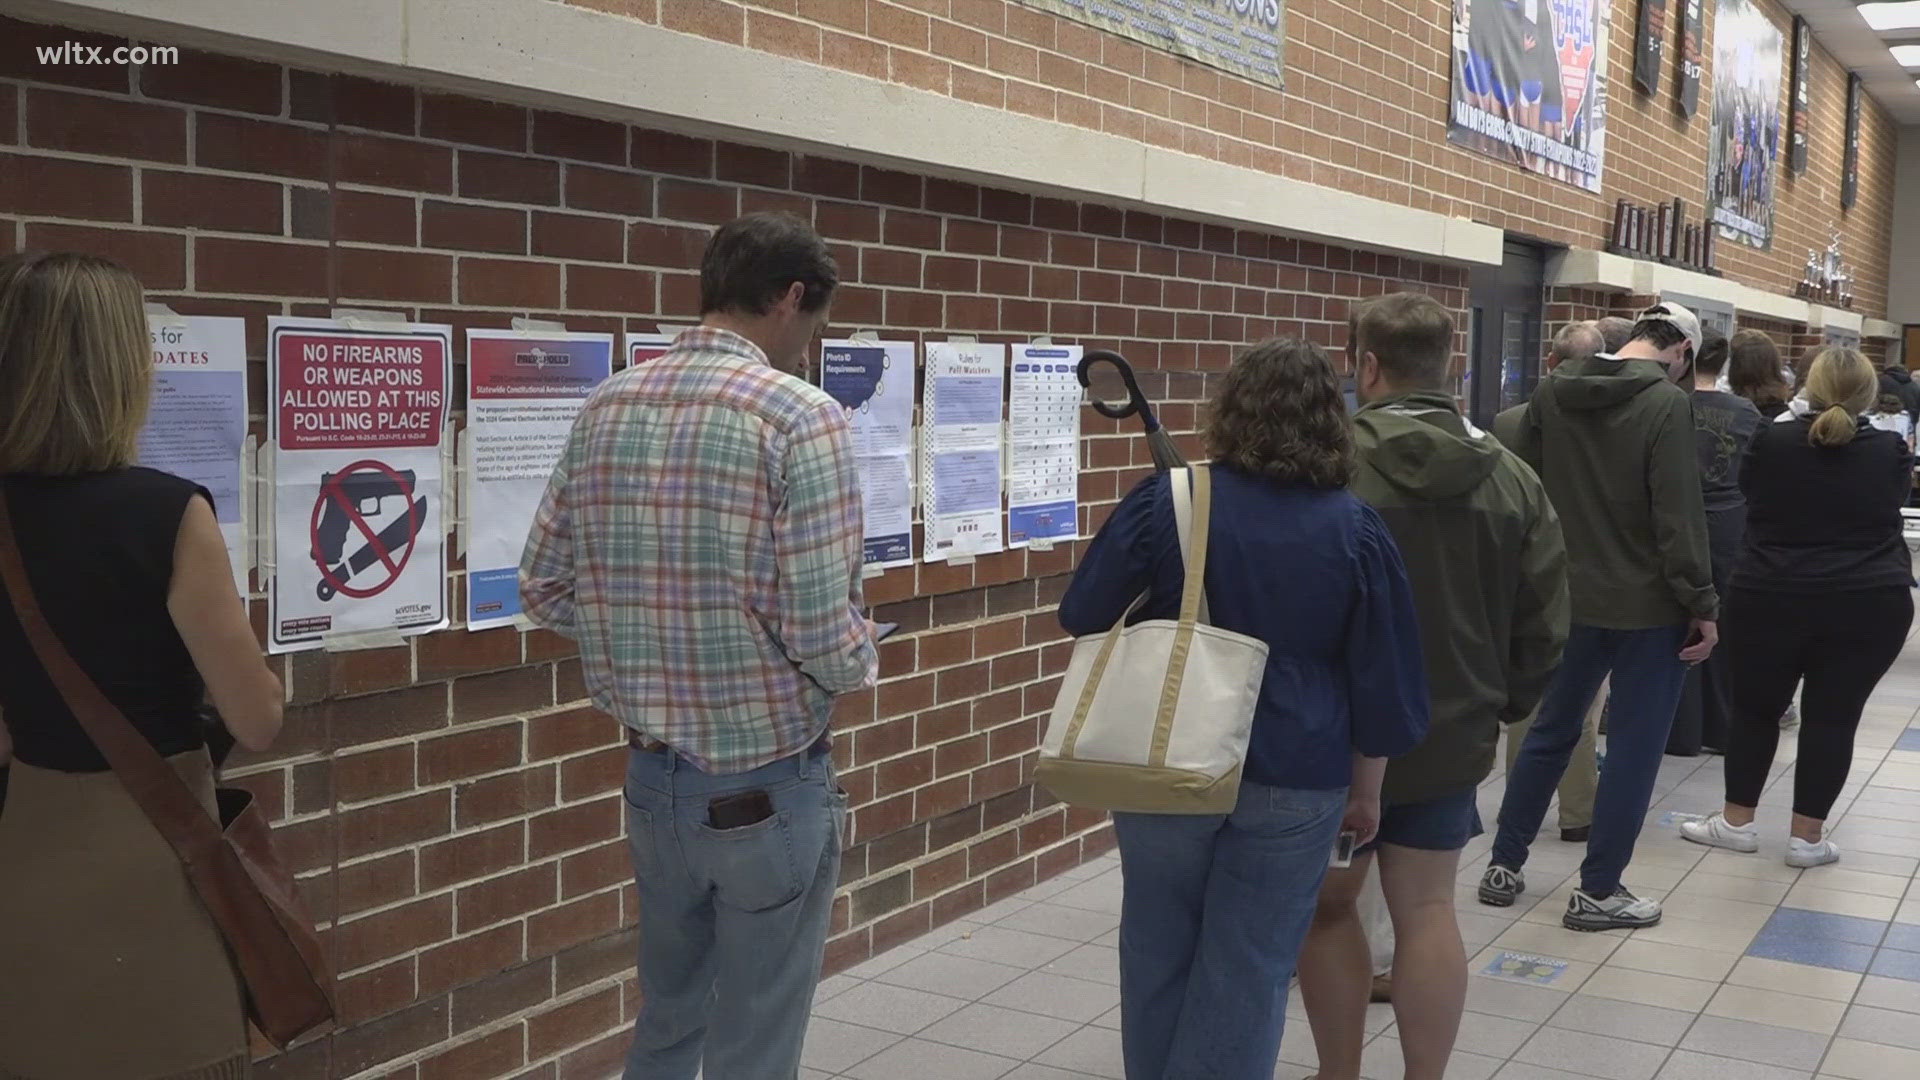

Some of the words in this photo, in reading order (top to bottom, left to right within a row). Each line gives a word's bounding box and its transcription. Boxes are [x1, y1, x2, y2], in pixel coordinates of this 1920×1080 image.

[1486, 112, 1505, 142] CROSS
[161, 326, 183, 344] for
[303, 343, 328, 362] NO
[332, 344, 423, 365] FIREARMS
[826, 352, 844, 362] Photo
[844, 353, 852, 362] ID
[958, 352, 974, 363] Rules
[974, 353, 982, 363] for
[825, 364, 866, 375] Requirements
[948, 365, 962, 374] Poll
[303, 366, 329, 385] OR
[332, 367, 423, 386] WEAPONS
[476, 385, 506, 394] Statewide
[506, 385, 545, 394] Constitutional
[546, 385, 580, 394] Amendment
[282, 389, 372, 408] ALLOWED
[377, 390, 401, 408] AT
[404, 390, 441, 408] THIS
[486, 406, 509, 414] proposed
[293, 412, 373, 431] POLLING
[378, 411, 431, 429] PLACE
[296, 434, 321, 442] Pursuant
